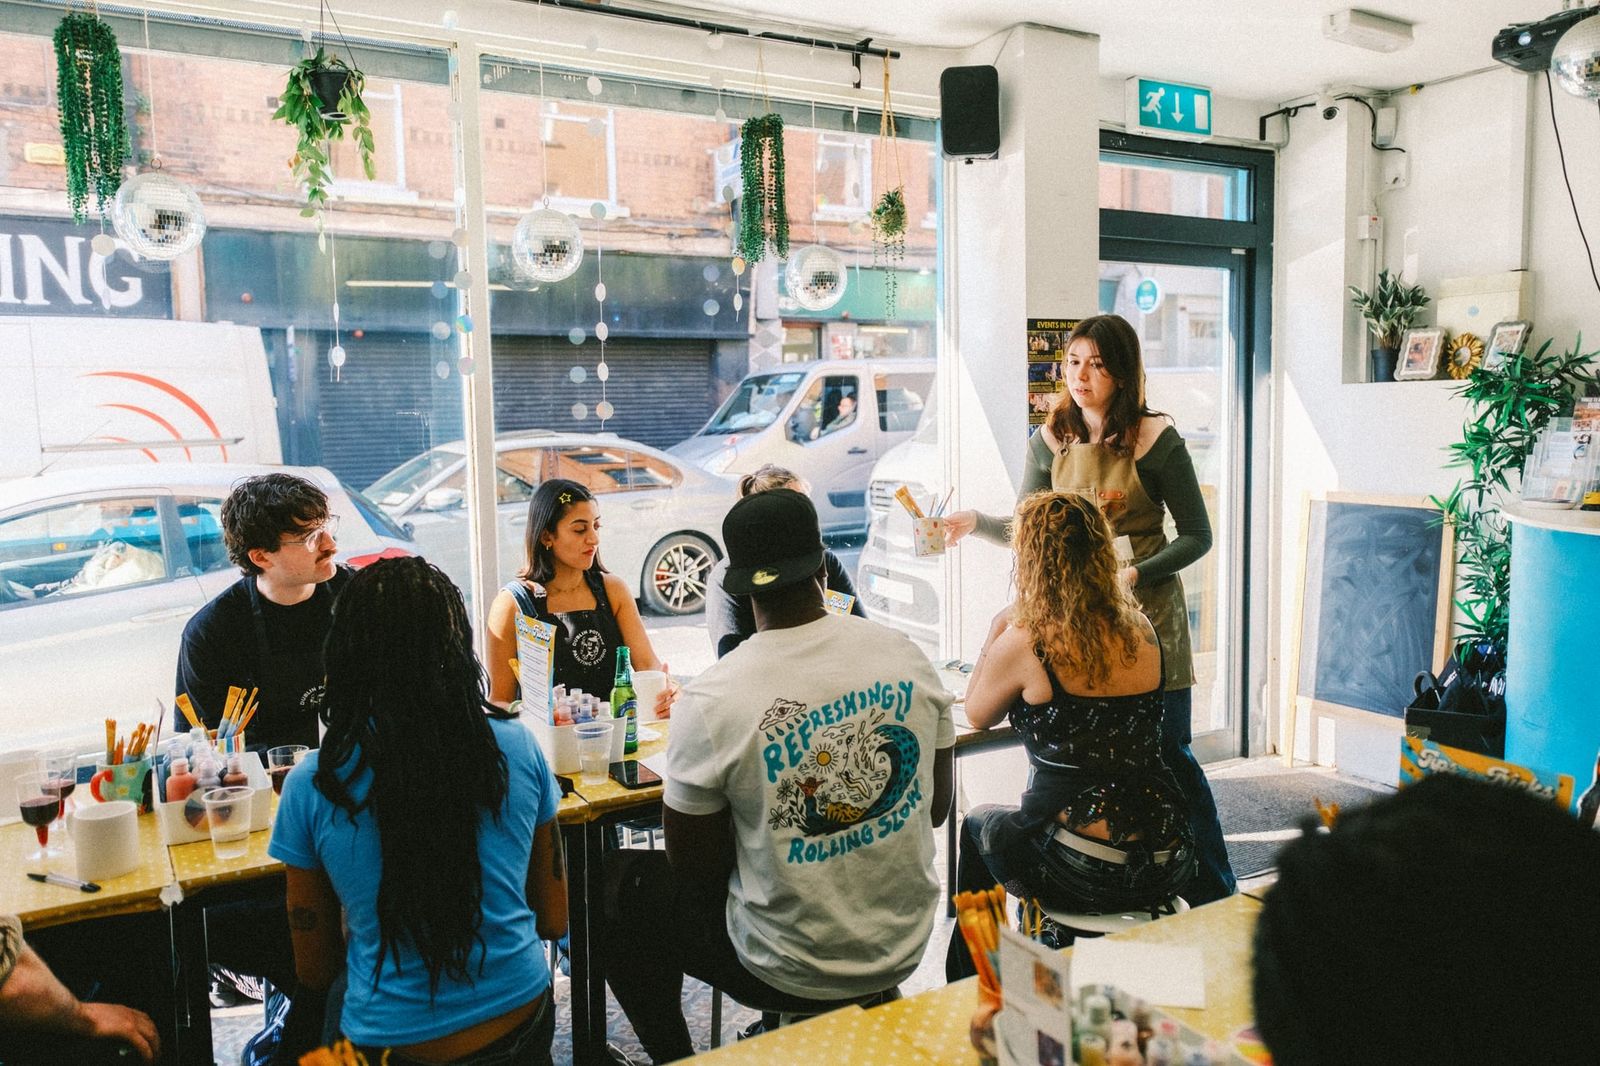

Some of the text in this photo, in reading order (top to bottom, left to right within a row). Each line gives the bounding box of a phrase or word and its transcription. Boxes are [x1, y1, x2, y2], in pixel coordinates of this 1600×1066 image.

[1037, 321, 1059, 329] EVENTS
[1059, 321, 1067, 329] IN
[572, 630, 588, 646] DUBLIN
[300, 687, 317, 705] DUBLIN
[763, 680, 914, 783] REFRESHINGLY
[788, 778, 922, 864] ROLLING SLOW
